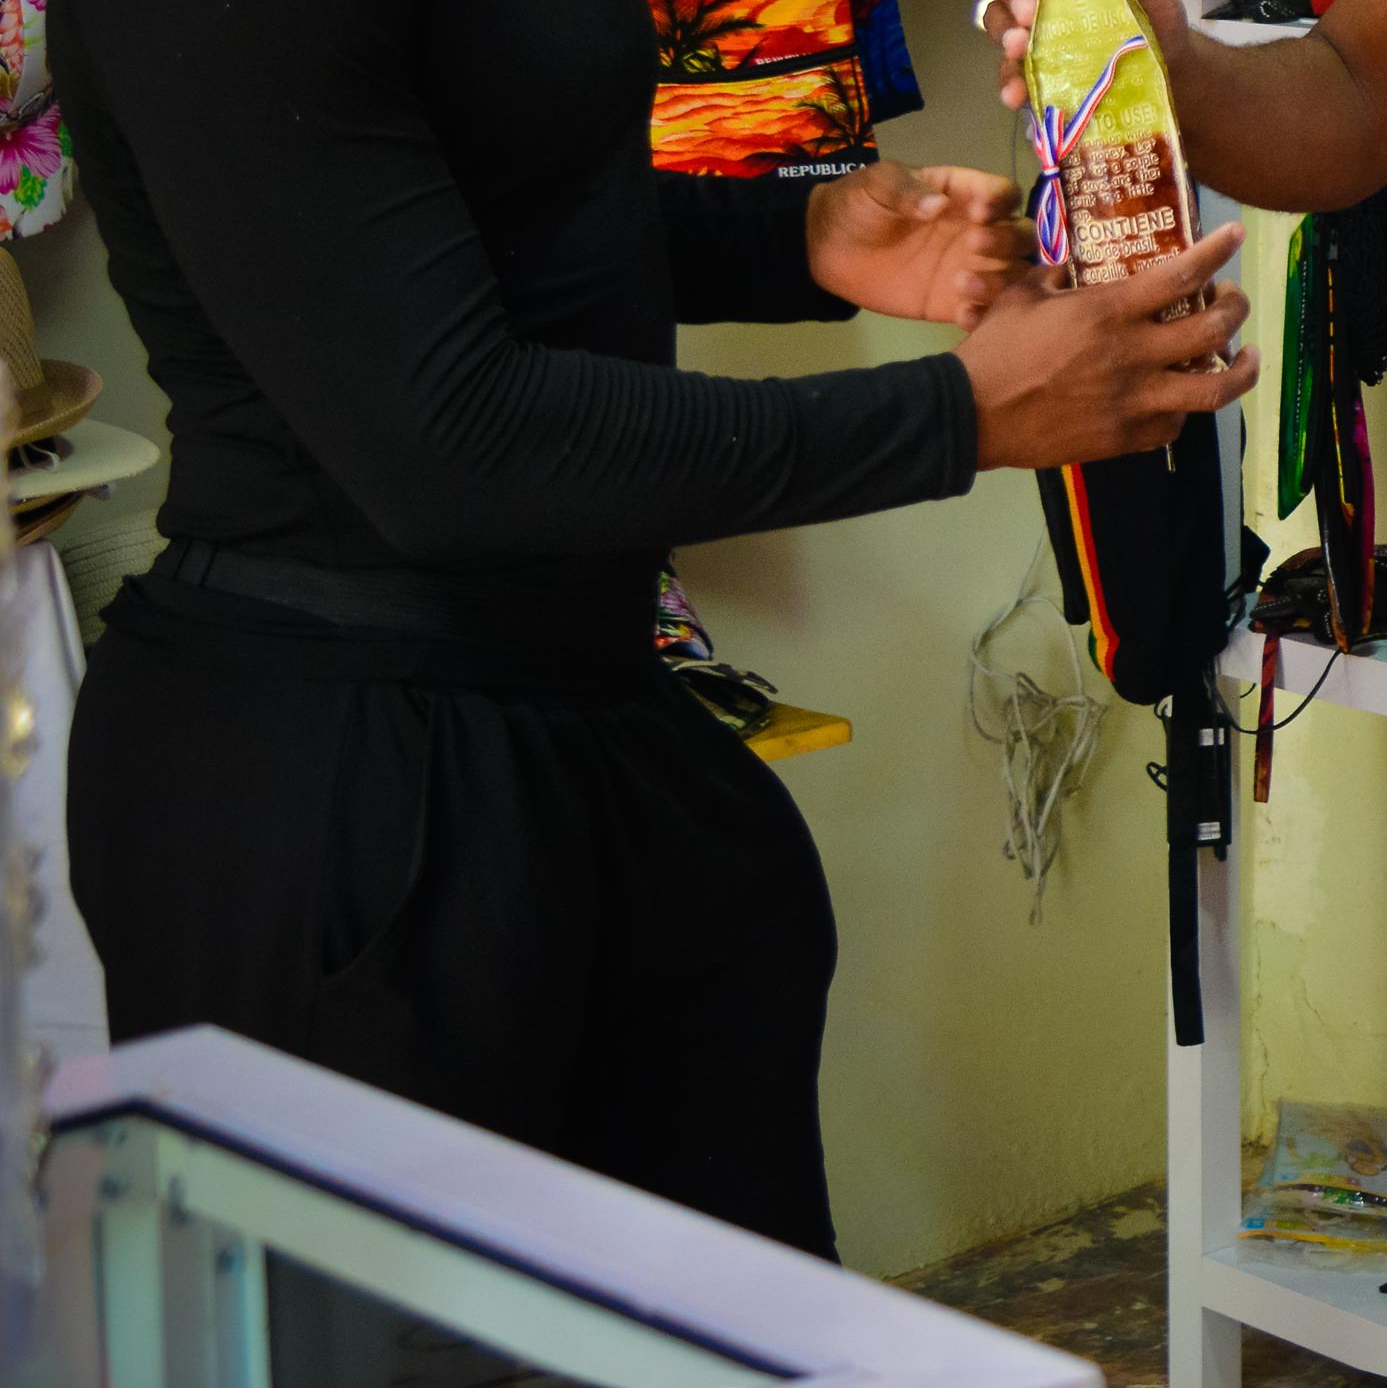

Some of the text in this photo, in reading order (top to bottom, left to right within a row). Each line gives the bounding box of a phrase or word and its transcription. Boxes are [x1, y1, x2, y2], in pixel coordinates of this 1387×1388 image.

[1075, 206, 1176, 243] CONTIENE
[1078, 244, 1102, 262] Palo
[1104, 241, 1119, 257] de
